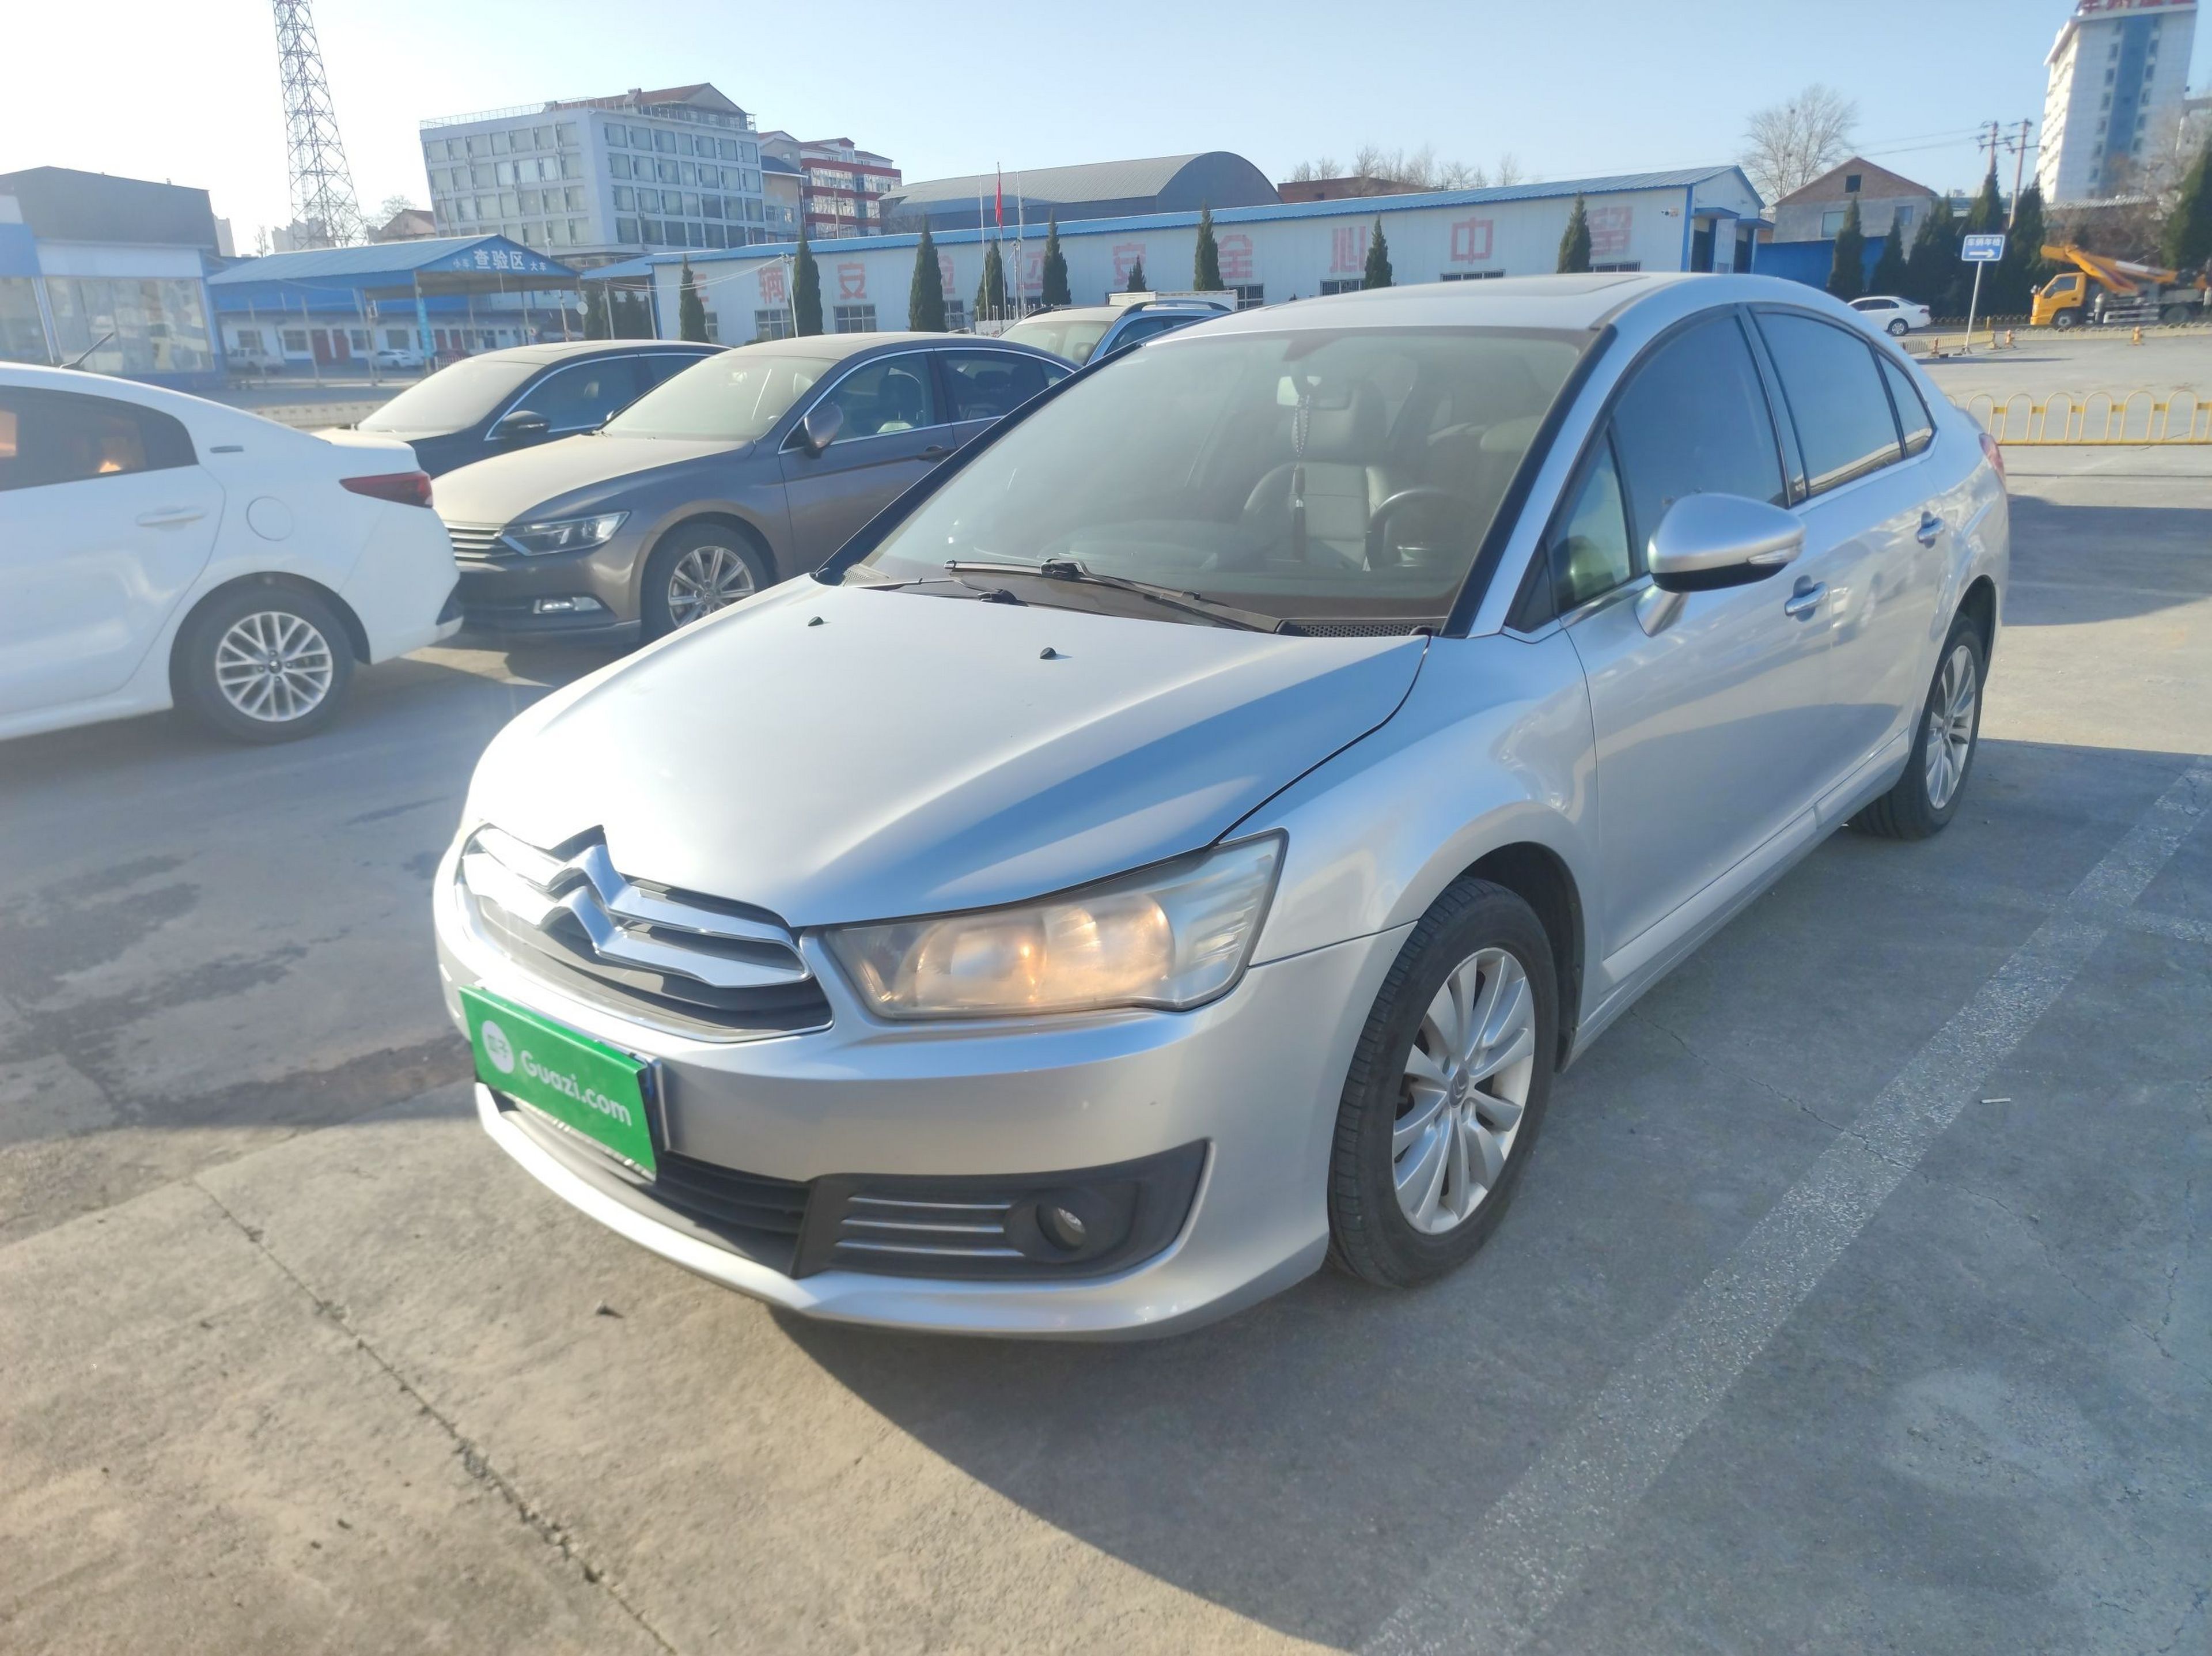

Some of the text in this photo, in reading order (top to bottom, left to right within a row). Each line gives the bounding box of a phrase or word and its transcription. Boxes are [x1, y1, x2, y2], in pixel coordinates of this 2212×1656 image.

[473, 249, 525, 270] 查验区
[530, 261, 547, 271] 大车
[520, 1050, 632, 1126] Guazi.com
